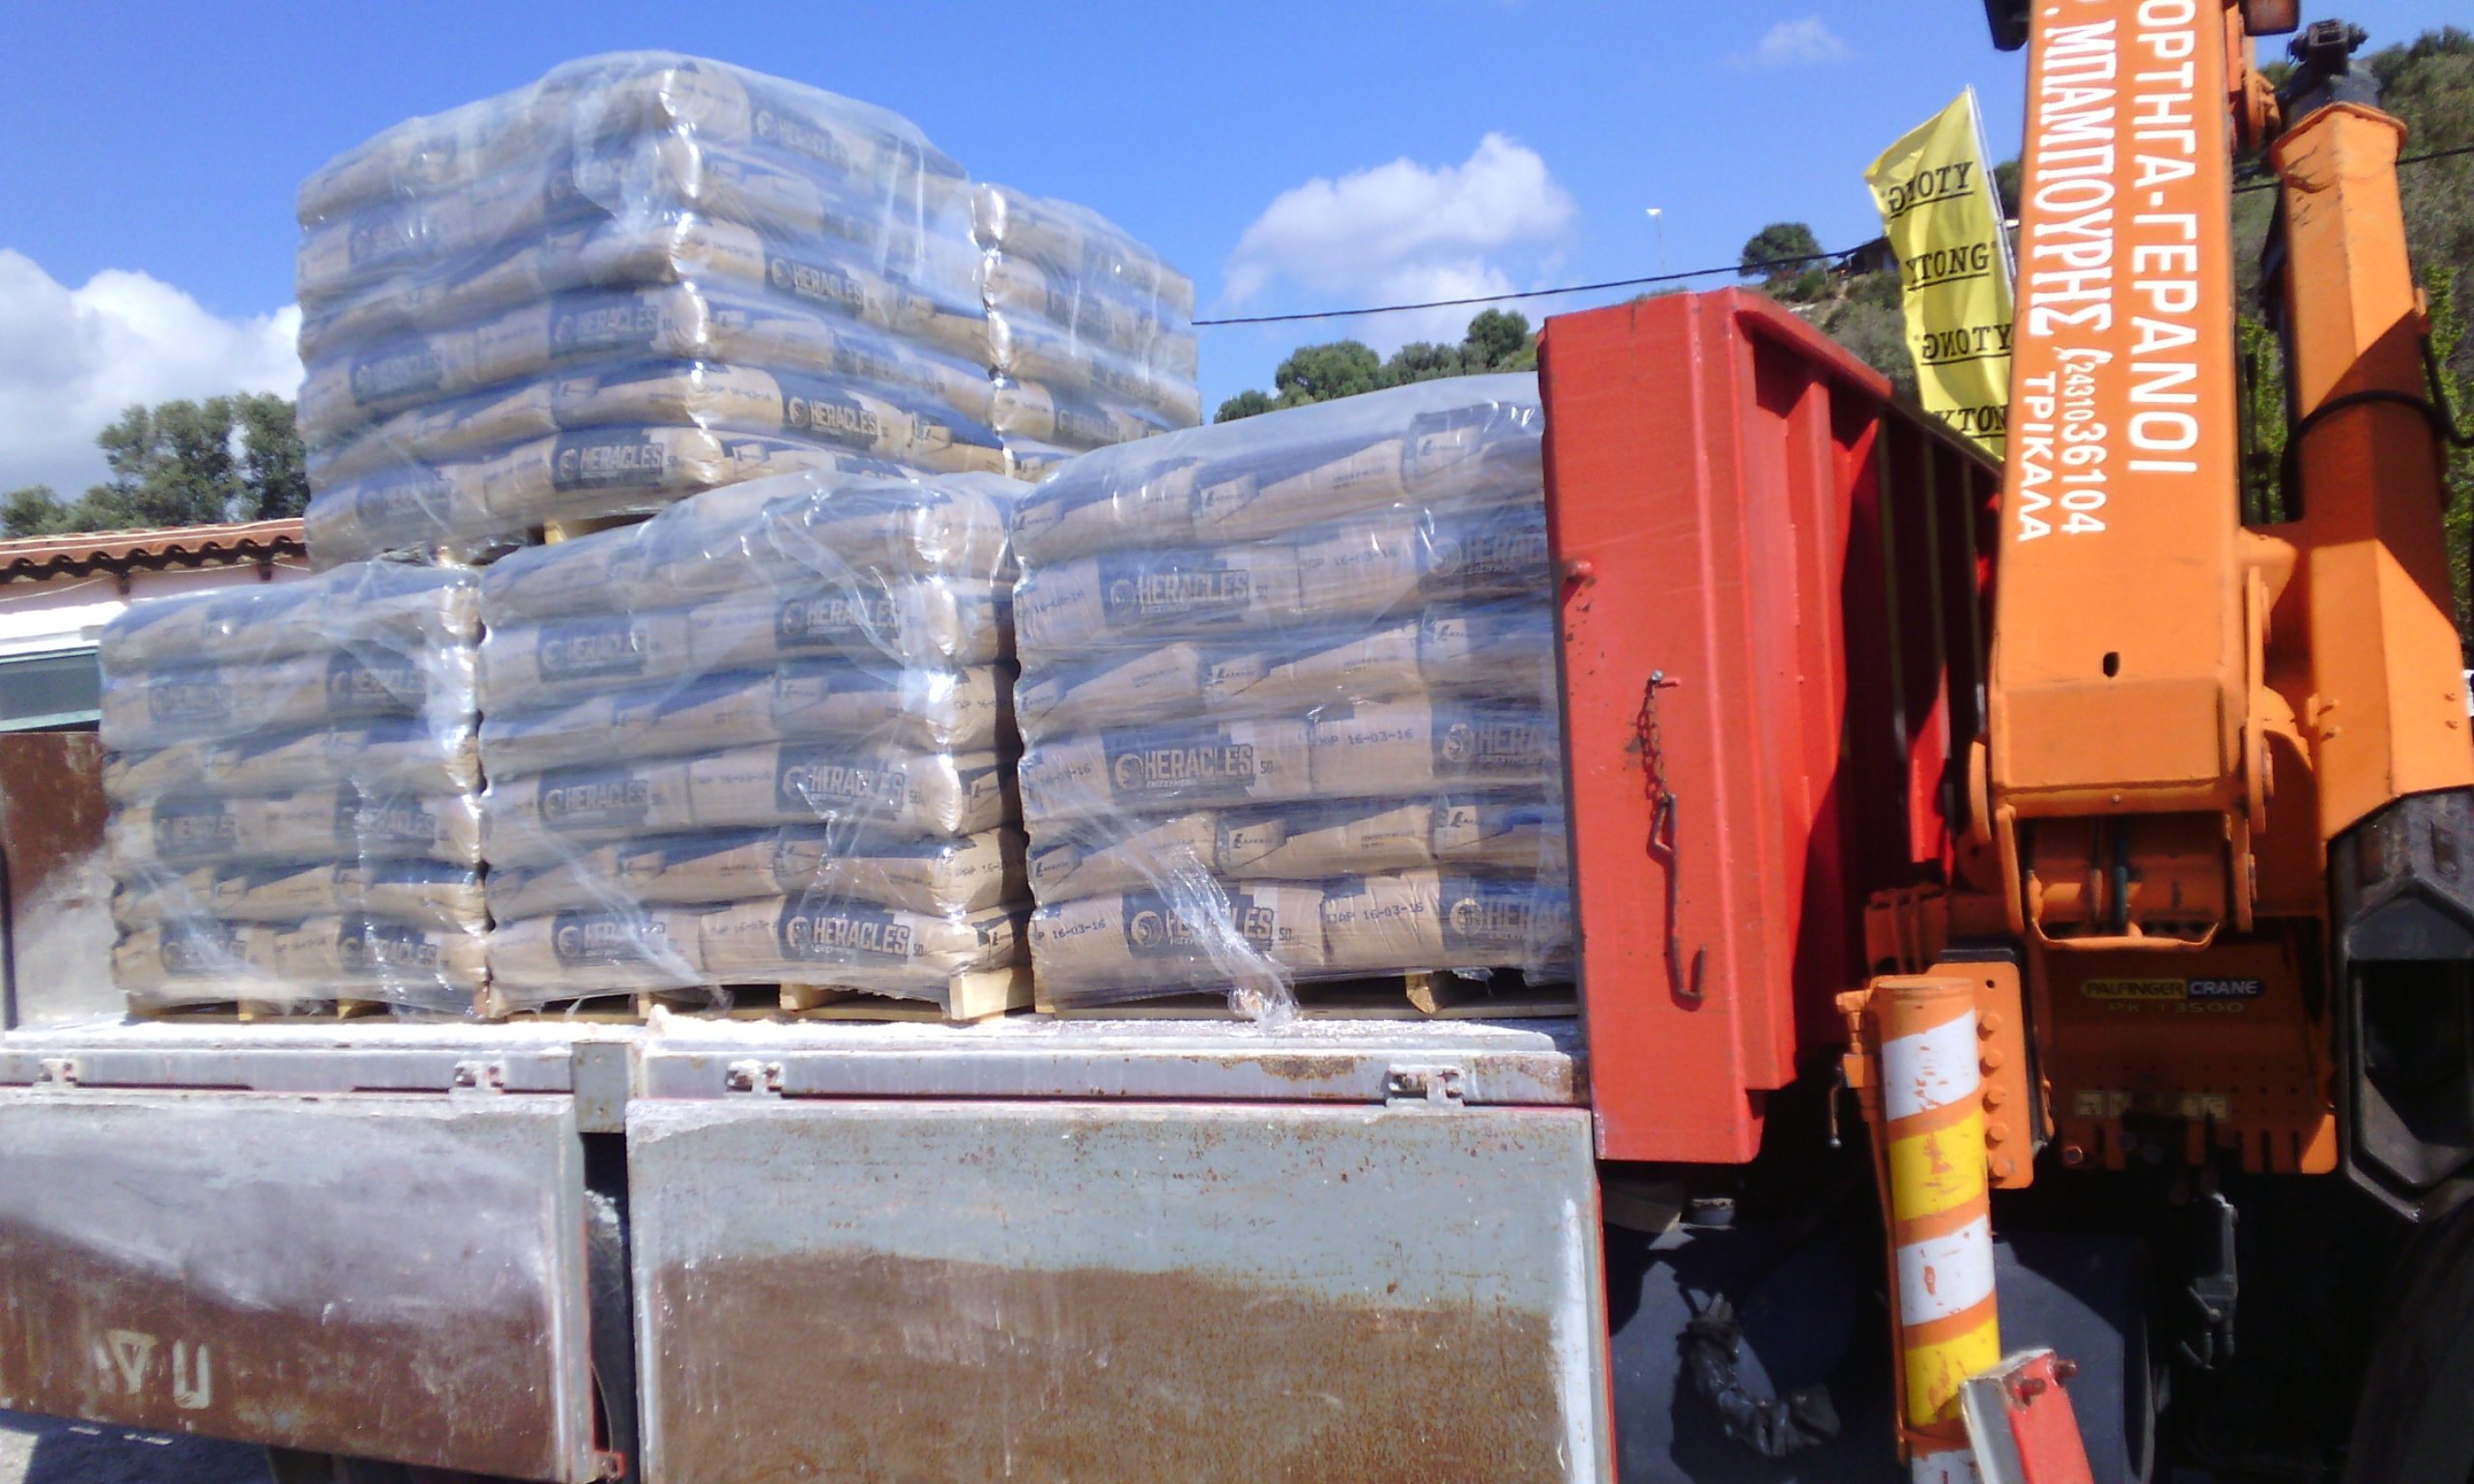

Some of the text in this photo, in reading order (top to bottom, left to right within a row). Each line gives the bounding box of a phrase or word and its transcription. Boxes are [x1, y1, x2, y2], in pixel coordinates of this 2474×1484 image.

[2028, 19, 2117, 337] ΜΠΑΜΠΟΥΡΗΣ
[809, 399, 877, 435] HERACLES
[580, 442, 664, 473] HERACLES
[2017, 370, 2057, 543] ΤΡΙΚΑΛΑ
[1136, 569, 1250, 606] HERACLES
[1346, 728, 1414, 745] 16-03-16
[1143, 743, 1254, 781] HERACLES
[1363, 903, 1424, 920] 16-03-16
[814, 916, 911, 956] HERACLES
[1052, 921, 1107, 940] 16-03-16
[2086, 980, 2258, 997] PALFINGER CRANE
